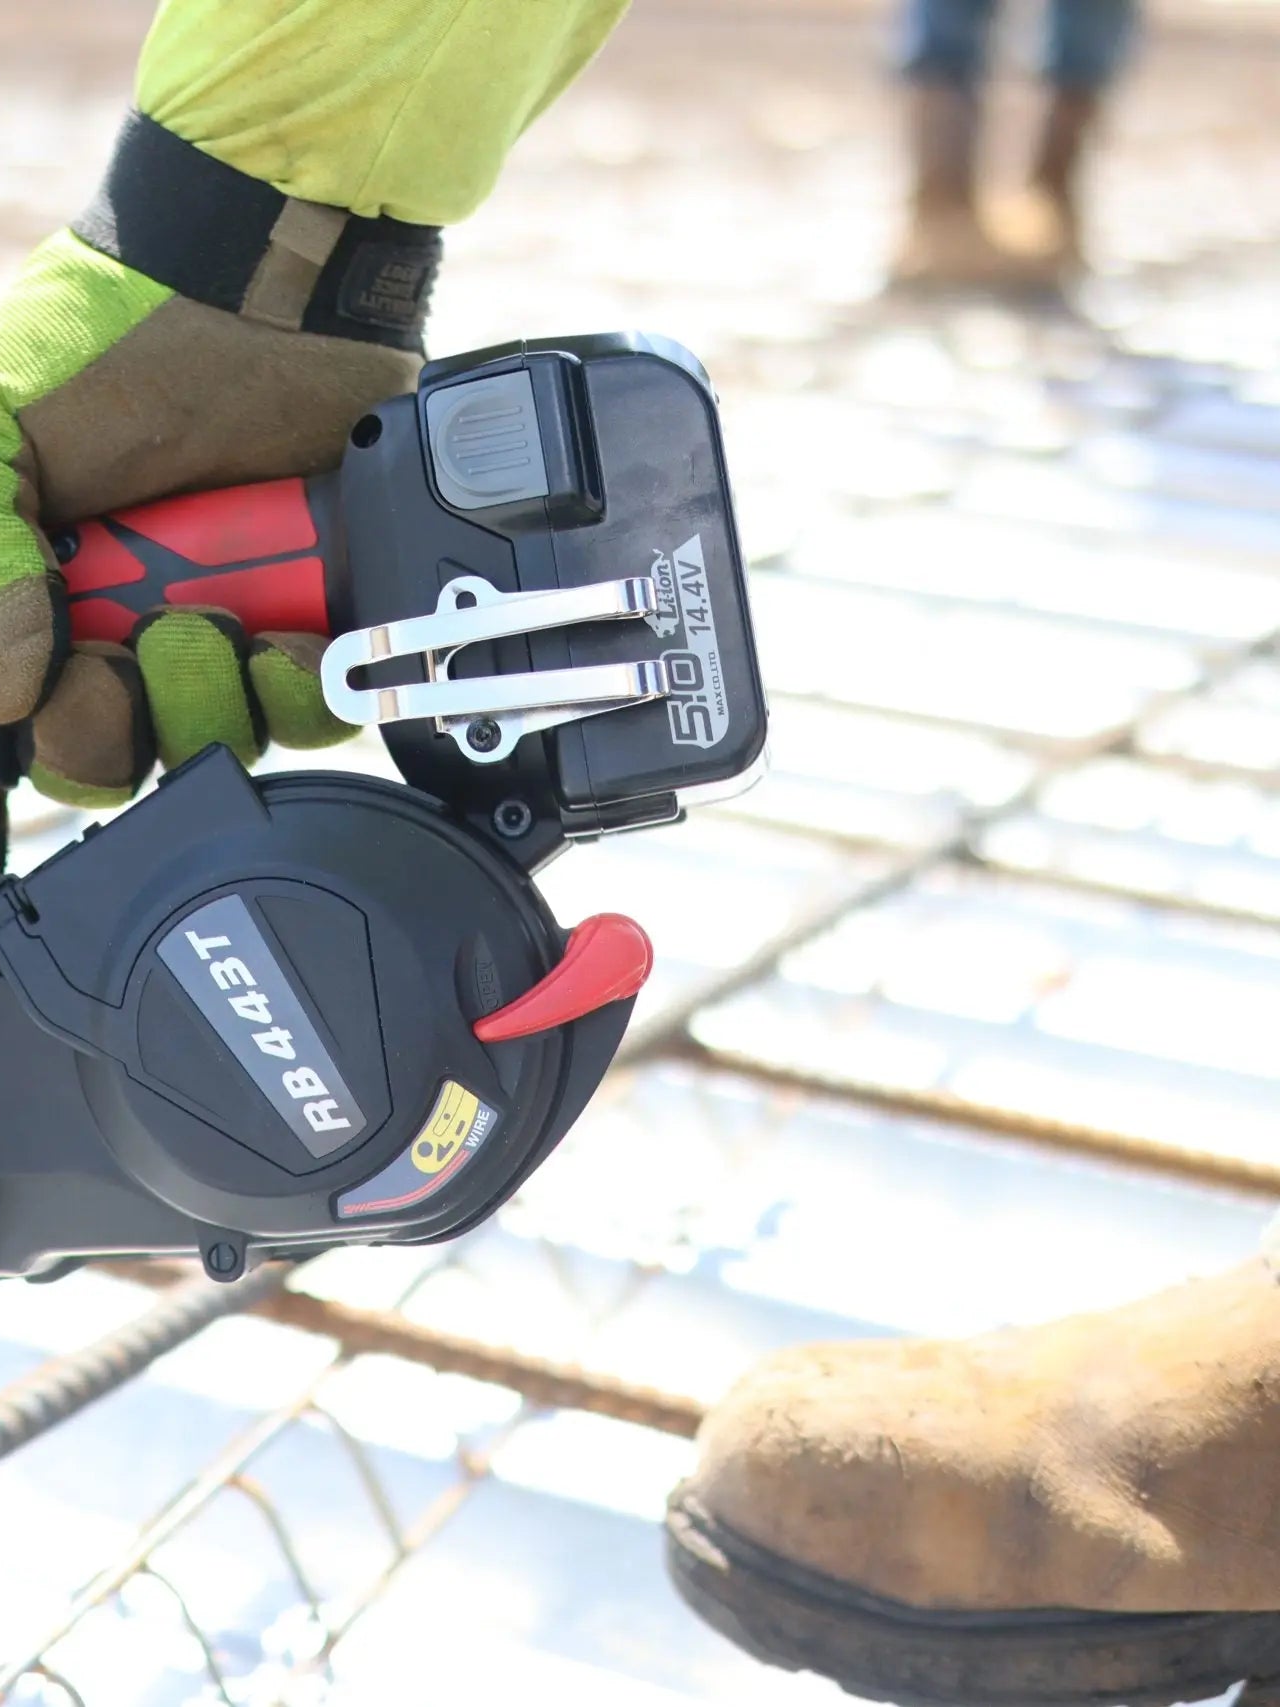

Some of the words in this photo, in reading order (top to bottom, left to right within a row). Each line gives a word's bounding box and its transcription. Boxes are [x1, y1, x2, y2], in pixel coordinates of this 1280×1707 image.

[677, 560, 712, 636] 14.4V
[666, 652, 714, 742] 5.0
[716, 691, 724, 716] MAX
[479, 960, 500, 1010] OPEN
[466, 1109, 490, 1148] WIRE
